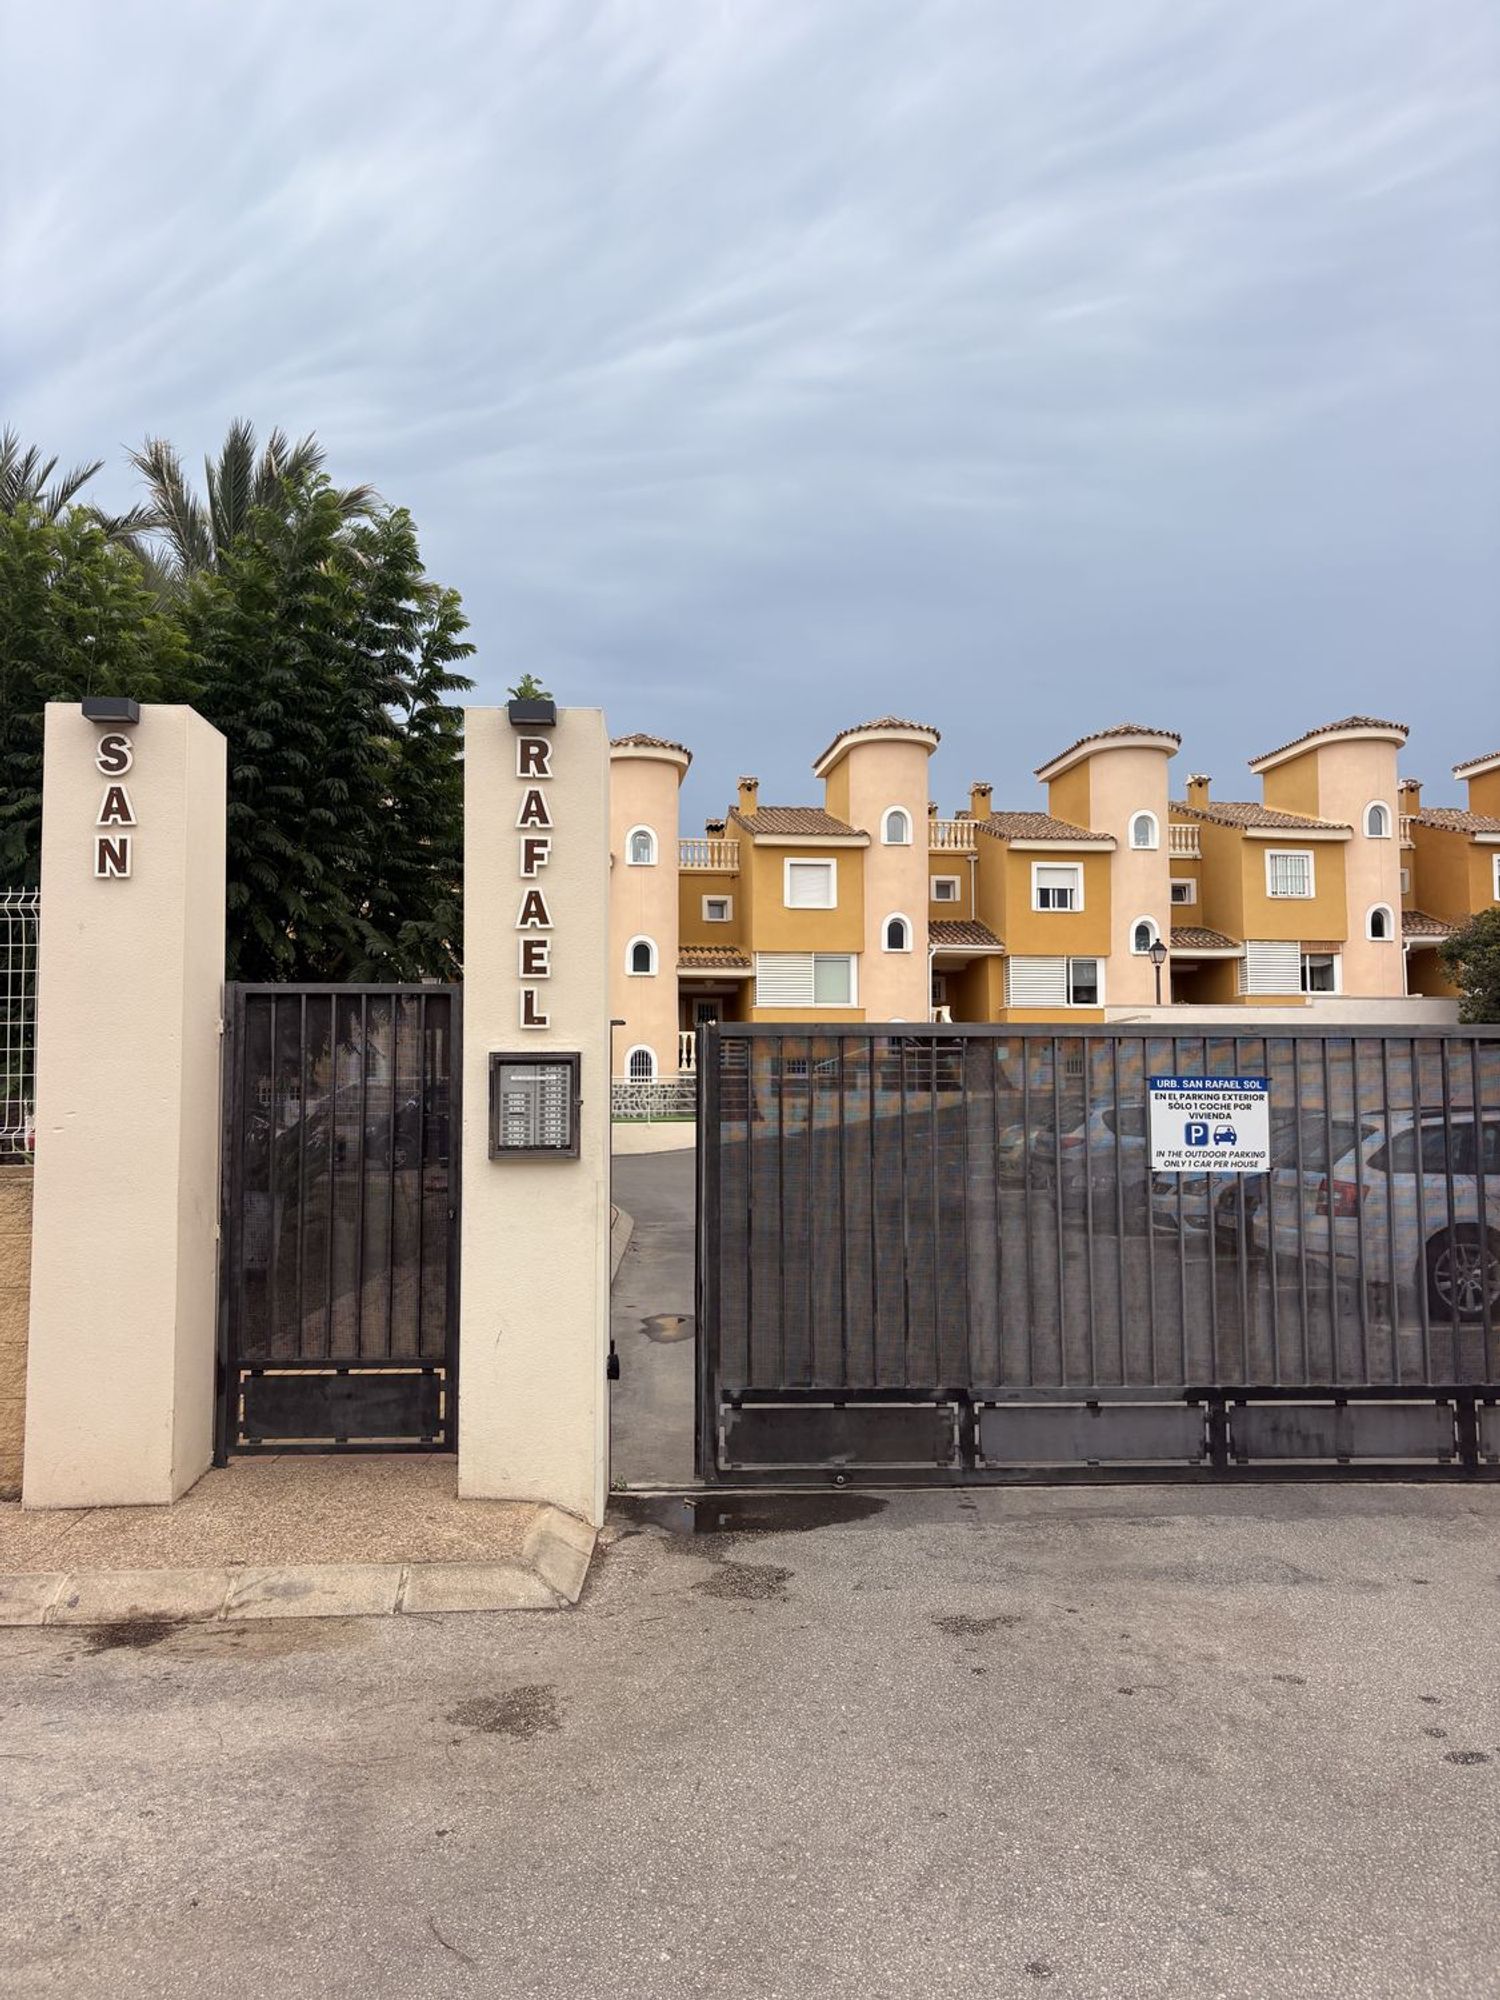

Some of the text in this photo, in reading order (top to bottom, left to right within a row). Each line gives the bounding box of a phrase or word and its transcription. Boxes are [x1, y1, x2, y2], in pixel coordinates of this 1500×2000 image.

[94, 733, 137, 878] SAN
[515, 735, 554, 1030] RAFAEL
[1157, 1080, 1262, 1089] URB. SAN RAFAEL SOL
[1179, 1093, 1220, 1101] PARKING
[1168, 1101, 1192, 1110] SÓLO
[1189, 1112, 1232, 1120] VIVIENDA
[1156, 1150, 1266, 1159] IN THE OUTDOOR PARKING
[1164, 1160, 1187, 1168] ONLY
[1193, 1160, 1210, 1168] CAR
